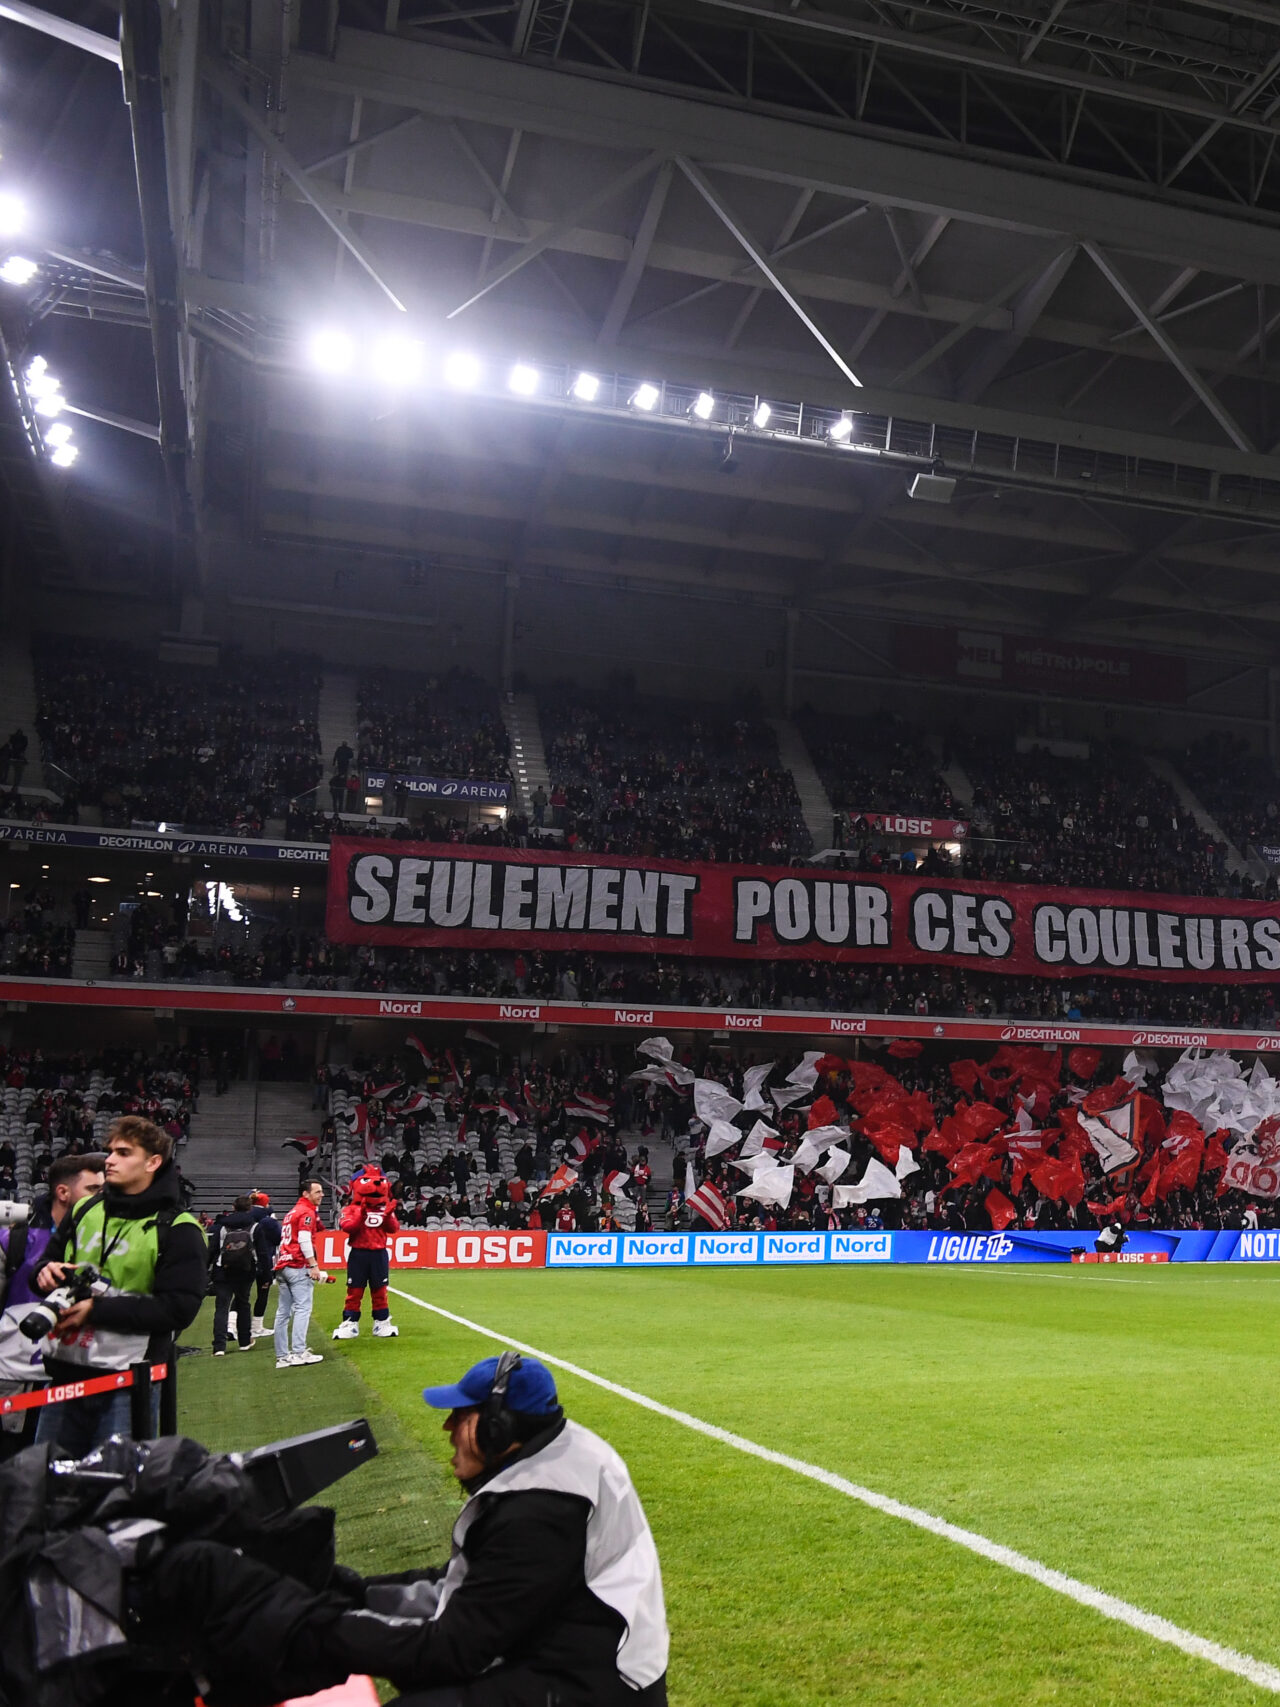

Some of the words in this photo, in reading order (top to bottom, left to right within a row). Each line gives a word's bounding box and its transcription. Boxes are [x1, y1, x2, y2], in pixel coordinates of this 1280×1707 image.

[367, 778, 437, 793] DEHLON
[460, 785, 508, 798] ARENA
[885, 817, 932, 835] LOSC
[14, 829, 67, 843] ARENA
[99, 836, 173, 851] DECATHLON
[198, 844, 248, 856] ARENA
[278, 848, 329, 861] DECATHL
[350, 854, 696, 935] SEULEMENT
[736, 879, 889, 945] POUR
[913, 893, 1012, 957] CES
[379, 1000, 422, 1014] Nord
[500, 1005, 540, 1018] Nord
[614, 1011, 654, 1023] Nord
[725, 1015, 763, 1028] Nord
[830, 1019, 866, 1032] Nord
[1017, 1028, 1080, 1041] DECATHLON
[1147, 1033, 1207, 1046] DECATHLON
[324, 1237, 419, 1264] LC
[436, 1236, 533, 1264] LOSC
[555, 1239, 612, 1256] Nord
[629, 1238, 684, 1255] Nord
[699, 1238, 753, 1255] Nord
[768, 1237, 820, 1253] Nord
[836, 1236, 886, 1252] Nord
[1117, 1253, 1144, 1264] LOSC
[47, 1383, 85, 1403] LOSC
